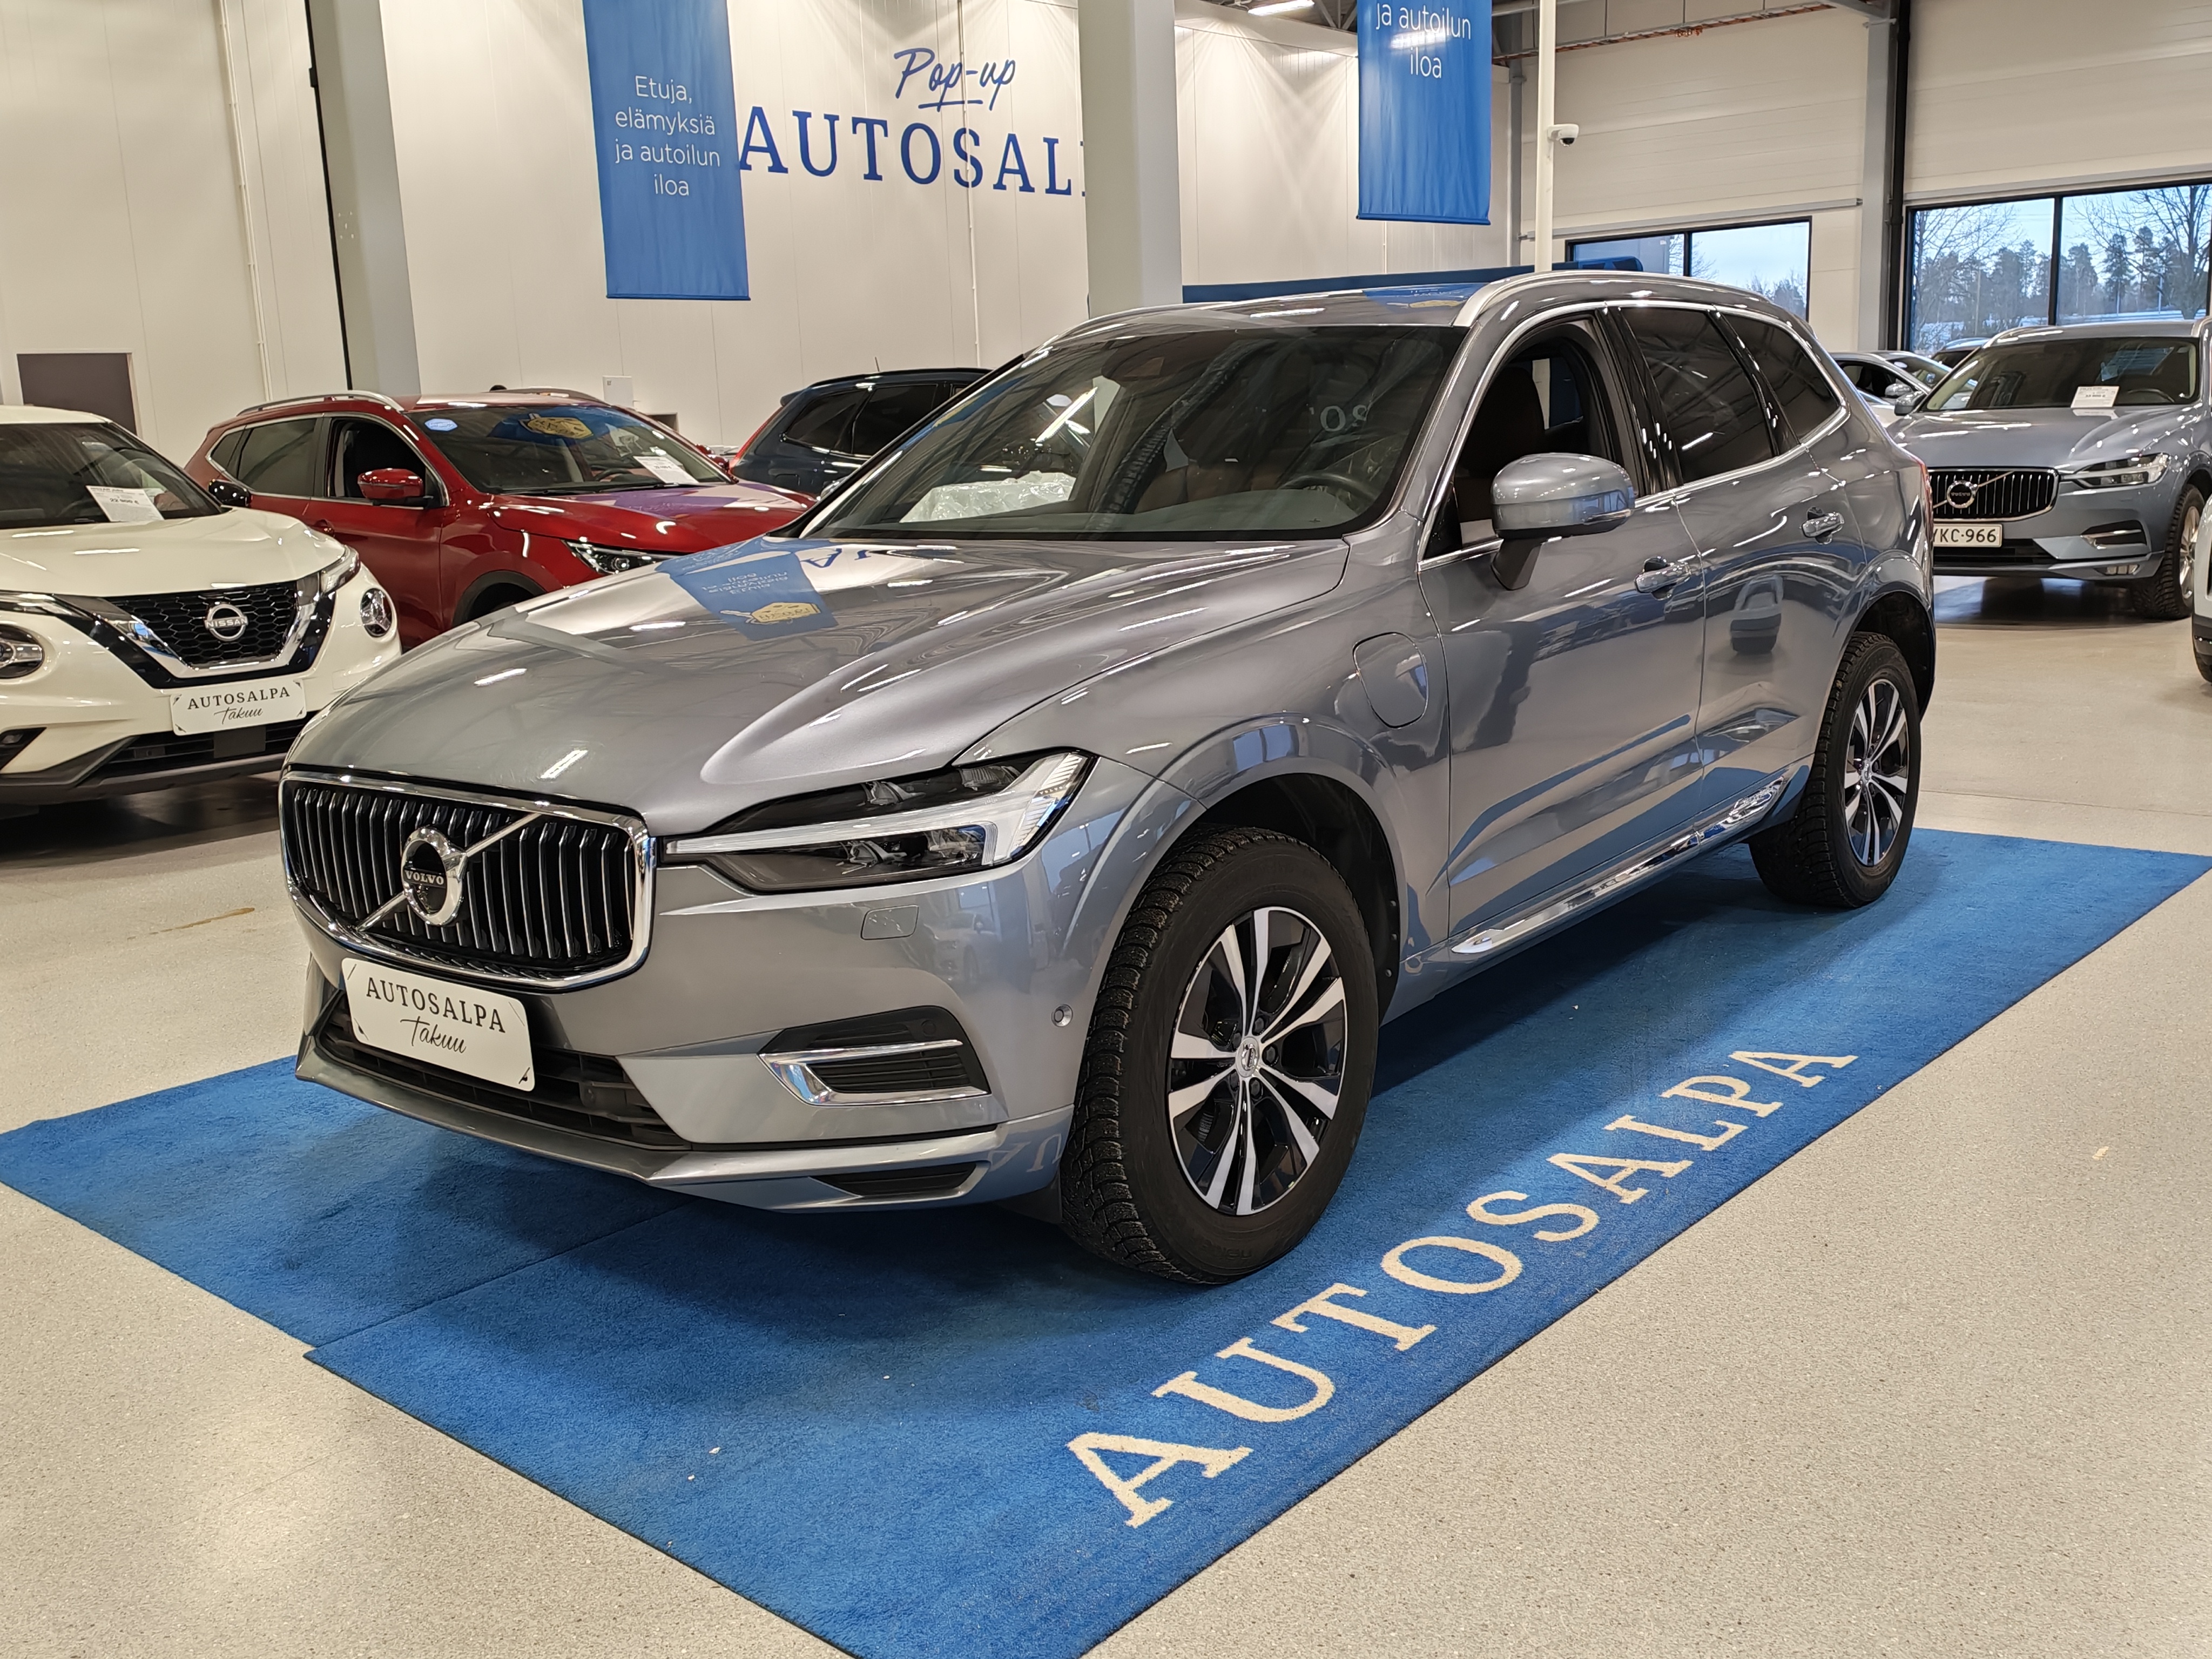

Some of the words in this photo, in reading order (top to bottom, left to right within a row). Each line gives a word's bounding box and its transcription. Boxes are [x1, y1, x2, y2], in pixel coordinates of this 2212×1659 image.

[1399, 5, 1471, 39] autoilun
[1410, 46, 1442, 78] iloa
[635, 75, 692, 104] Etuja,
[893, 47, 1016, 112] Pop-up
[615, 106, 716, 135] elämyksiä
[615, 138, 633, 164] ja
[640, 143, 720, 167] autoilun
[739, 105, 1086, 197] AUTOSAL
[653, 173, 690, 196] iloa
[206, 618, 247, 628] NISSAN
[187, 686, 291, 710] AUTOSALPA
[213, 707, 263, 725] Takuu
[404, 869, 444, 885] VOLVO
[366, 977, 506, 1034] AUTOSALPA
[400, 1016, 467, 1054] Takuu
[1067, 1050, 1858, 1528] AUTOSALPA
